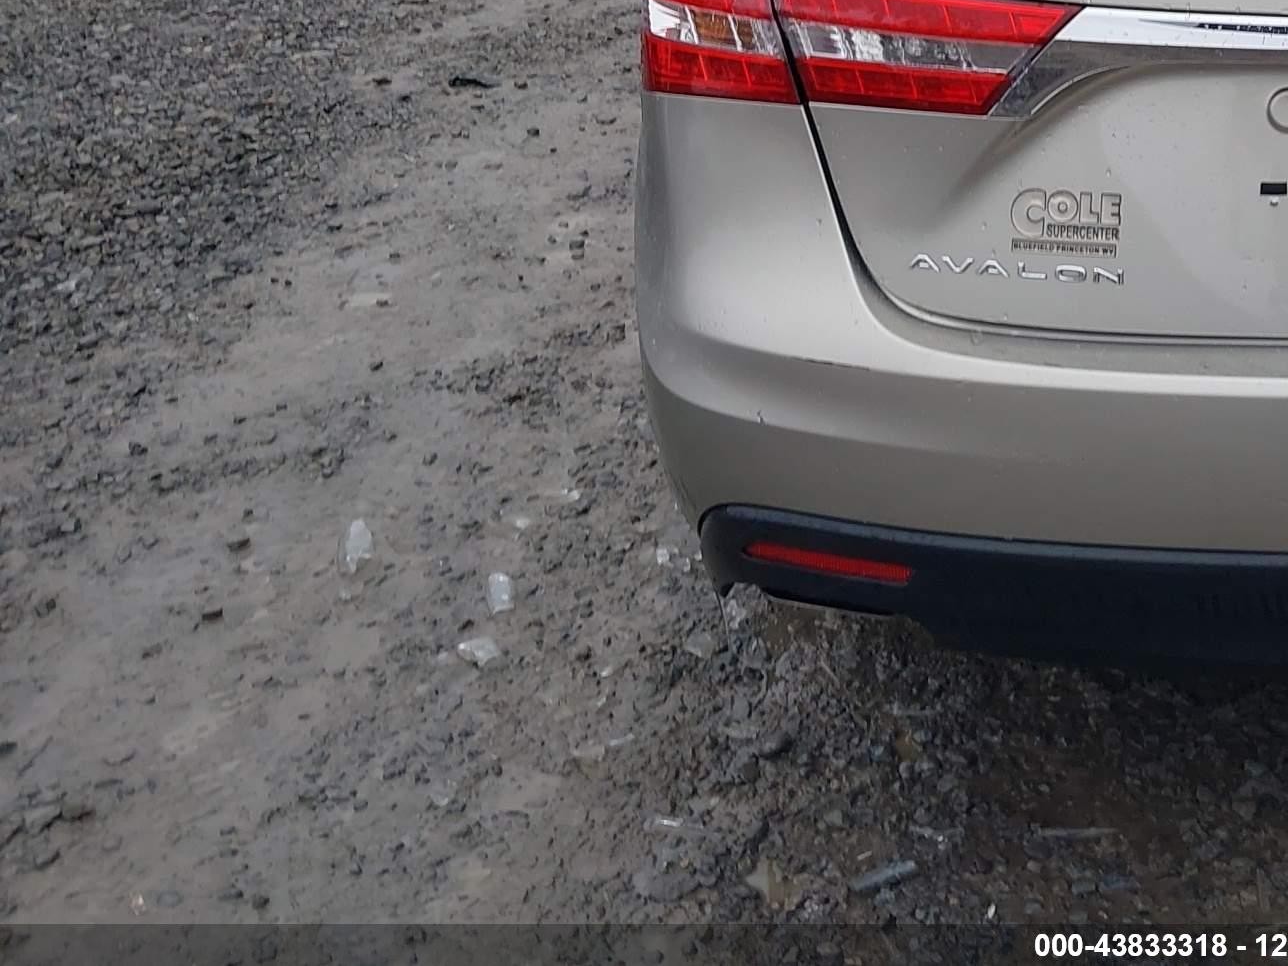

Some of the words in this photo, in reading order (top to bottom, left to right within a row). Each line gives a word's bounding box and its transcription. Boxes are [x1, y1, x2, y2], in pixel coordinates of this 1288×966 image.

[1010, 188, 1122, 237] COLE
[1046, 224, 1120, 240] SUPERCENTER
[1012, 241, 1054, 252] BLUEFIELD
[1056, 244, 1100, 254] PRINCETON
[909, 253, 1125, 285] AVALON
